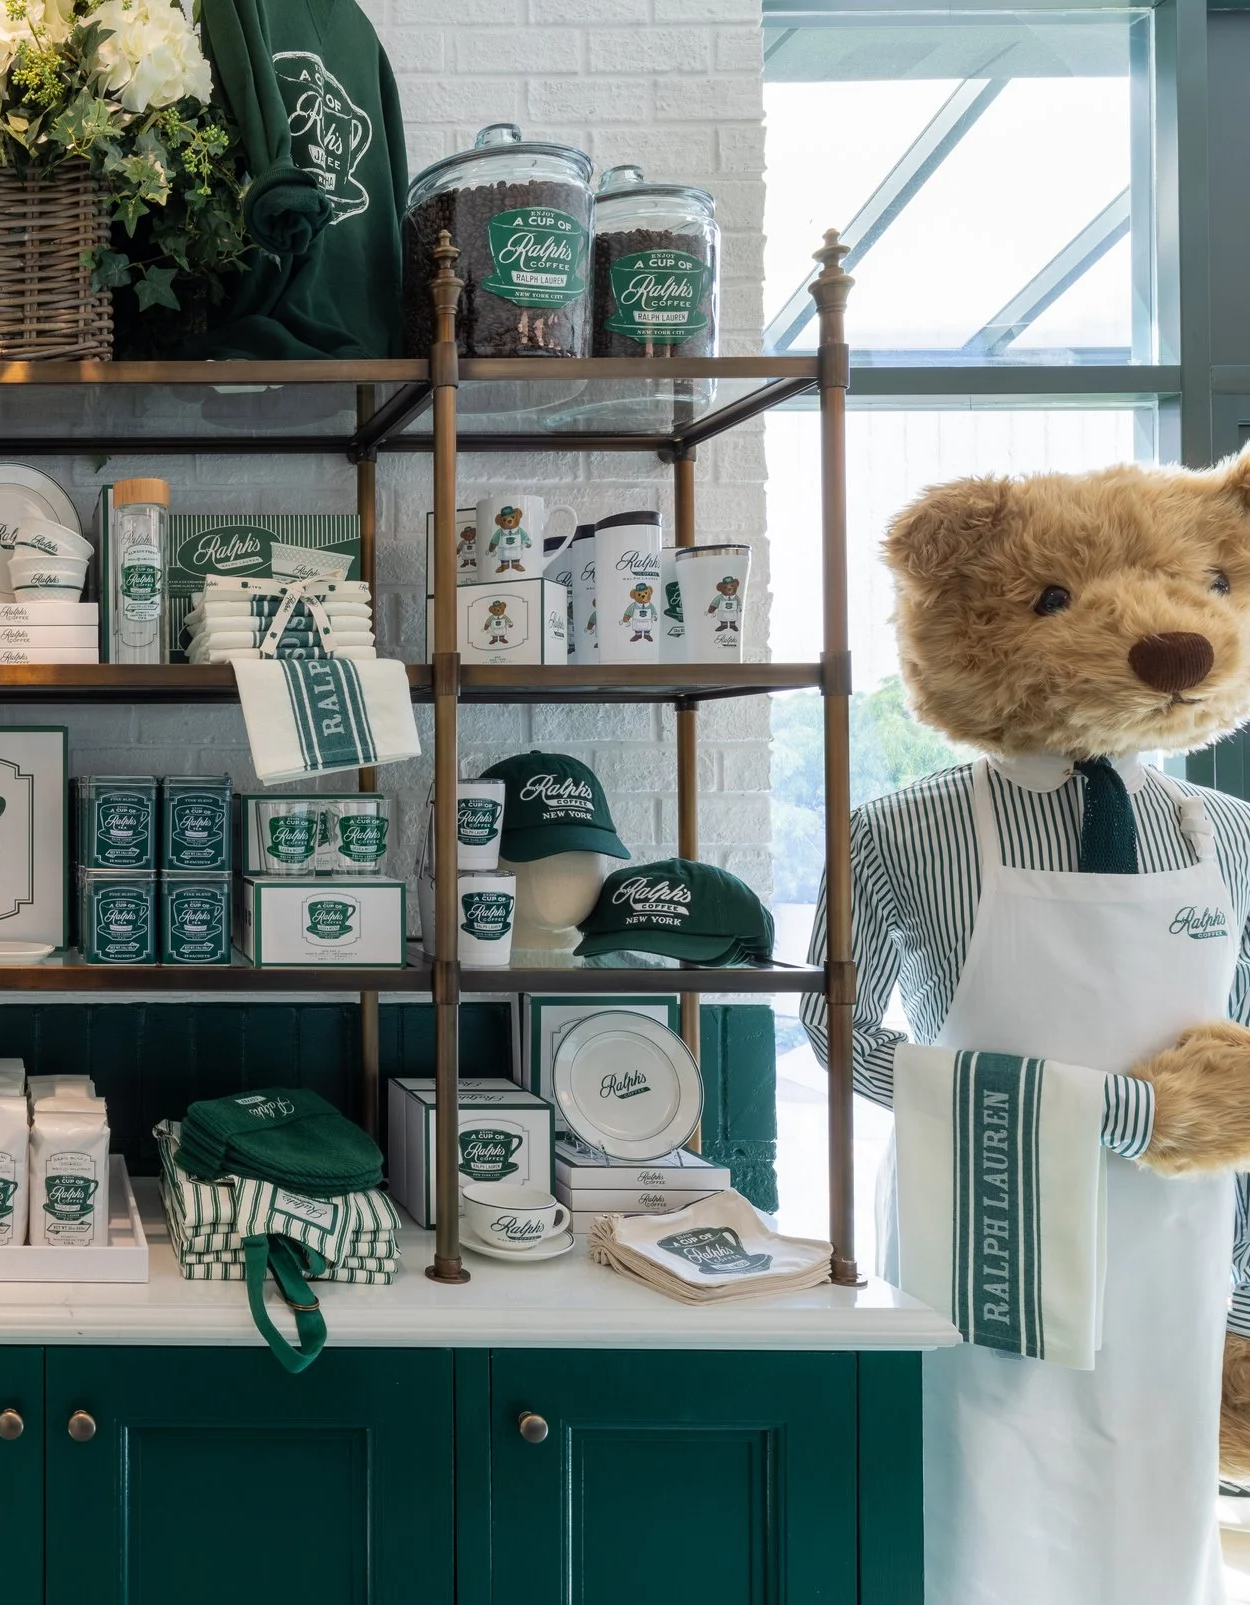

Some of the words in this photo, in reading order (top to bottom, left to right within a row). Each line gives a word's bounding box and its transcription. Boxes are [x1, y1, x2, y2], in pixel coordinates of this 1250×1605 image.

[325, 94, 342, 112] OF
[513, 218, 524, 226] A
[529, 216, 554, 226] CUP
[557, 220, 572, 231] OF
[499, 232, 572, 272] Ralph's
[530, 261, 570, 271] COFFEE
[633, 260, 645, 269] A
[648, 258, 675, 268] CUP
[678, 260, 693, 270] OF
[516, 273, 538, 283] RALPH
[540, 275, 565, 285] LAUREN
[620, 274, 693, 311] Ralph's
[651, 300, 692, 308] COFFEE
[637, 312, 659, 321] RALPH
[661, 313, 686, 322] LAUREN
[193, 533, 261, 568] Ralph's
[308, 661, 345, 737] RALP
[520, 774, 592, 803] Ralph's
[105, 814, 136, 830] Ralph's
[180, 816, 211, 831] Ralph's
[458, 810, 492, 828] Ralph's
[542, 811, 565, 820] NEW
[568, 811, 592, 820] YORK
[273, 828, 308, 846] Ralph's
[344, 827, 380, 845] Ralph's
[612, 877, 691, 907] Ralph's
[467, 904, 506, 923] Ralph's
[641, 903, 679, 911] COFFEE
[104, 910, 136, 925] Ralph's
[179, 910, 210, 925] Ralph's
[312, 910, 343, 925] Ralph's
[626, 916, 648, 924] NEW
[651, 916, 682, 926] YORK
[1169, 906, 1226, 937] Ralph's
[600, 1070, 647, 1098] Ralph's
[464, 1142, 505, 1163] Ralph's
[983, 1089, 1010, 1210] LAUREN
[637, 1171, 664, 1183] Ralph's
[50, 1186, 84, 1204] Ralph's
[638, 1193, 664, 1205] Ralph's
[491, 1216, 544, 1238] Ralph's
[680, 1237, 697, 1245] CUP
[683, 1244, 733, 1264] Ralph's
[983, 1216, 1010, 1325] RALPH
